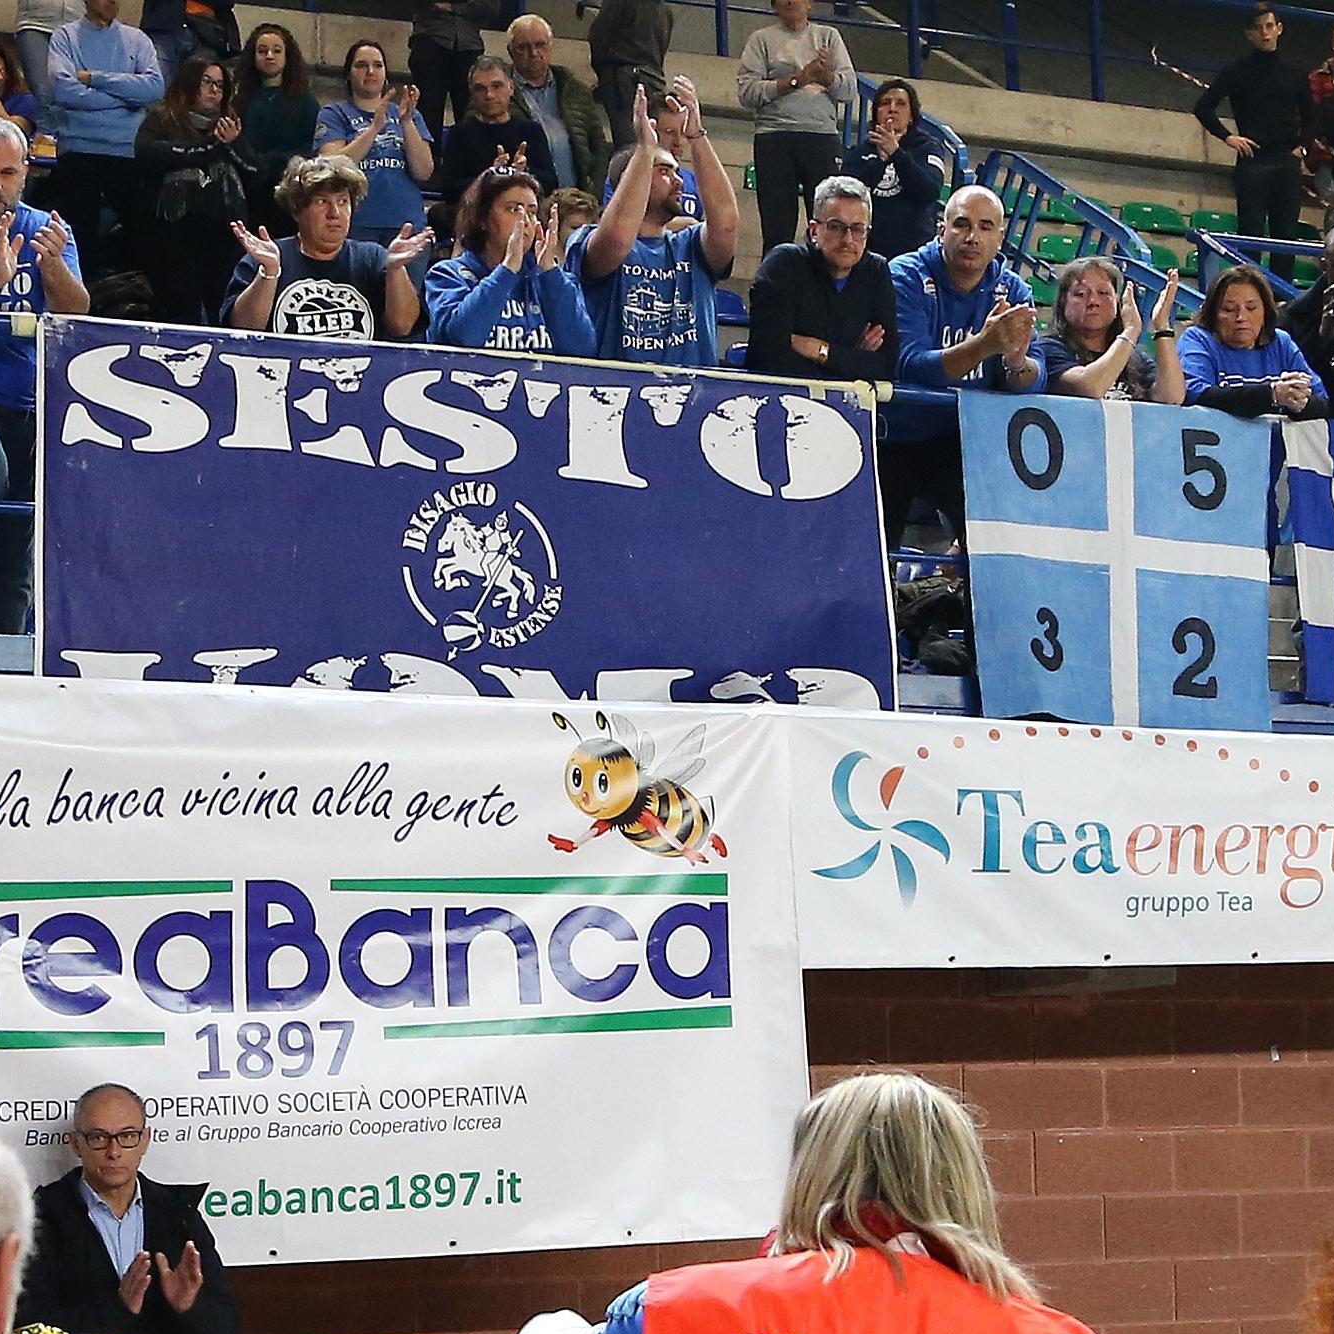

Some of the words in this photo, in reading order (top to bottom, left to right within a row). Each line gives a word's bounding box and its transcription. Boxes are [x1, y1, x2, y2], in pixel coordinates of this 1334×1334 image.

[291, 285, 358, 305] BASKET
[295, 311, 355, 334] KLEB
[61, 343, 865, 499] SESTO
[1007, 407, 1064, 490] 0
[1182, 428, 1227, 510] 5
[402, 481, 498, 553] DISAGIO
[488, 584, 563, 649] ESTENSE
[1030, 607, 1064, 672] 3
[1171, 617, 1218, 698] 2
[46, 767, 165, 826] banca
[181, 771, 297, 818] vicina
[312, 761, 392, 819] alla
[394, 782, 520, 843] gente
[1125, 894, 1210, 919] gruppo
[1216, 890, 1254, 912] Tea
[194, 1020, 357, 1081] 1897
[143, 1093, 269, 1120] OPERATIVO
[277, 1085, 371, 1114] SOCIETÀ
[379, 1085, 529, 1112] COOPERATIVA
[175, 1124, 193, 1142] al
[198, 1121, 263, 1147] Gruppo
[268, 1119, 343, 1139] Bancario
[349, 1115, 448, 1141] Cooperativo
[452, 1114, 503, 1132] Iccrea
[205, 1169, 523, 1218] eabanca1897.it
